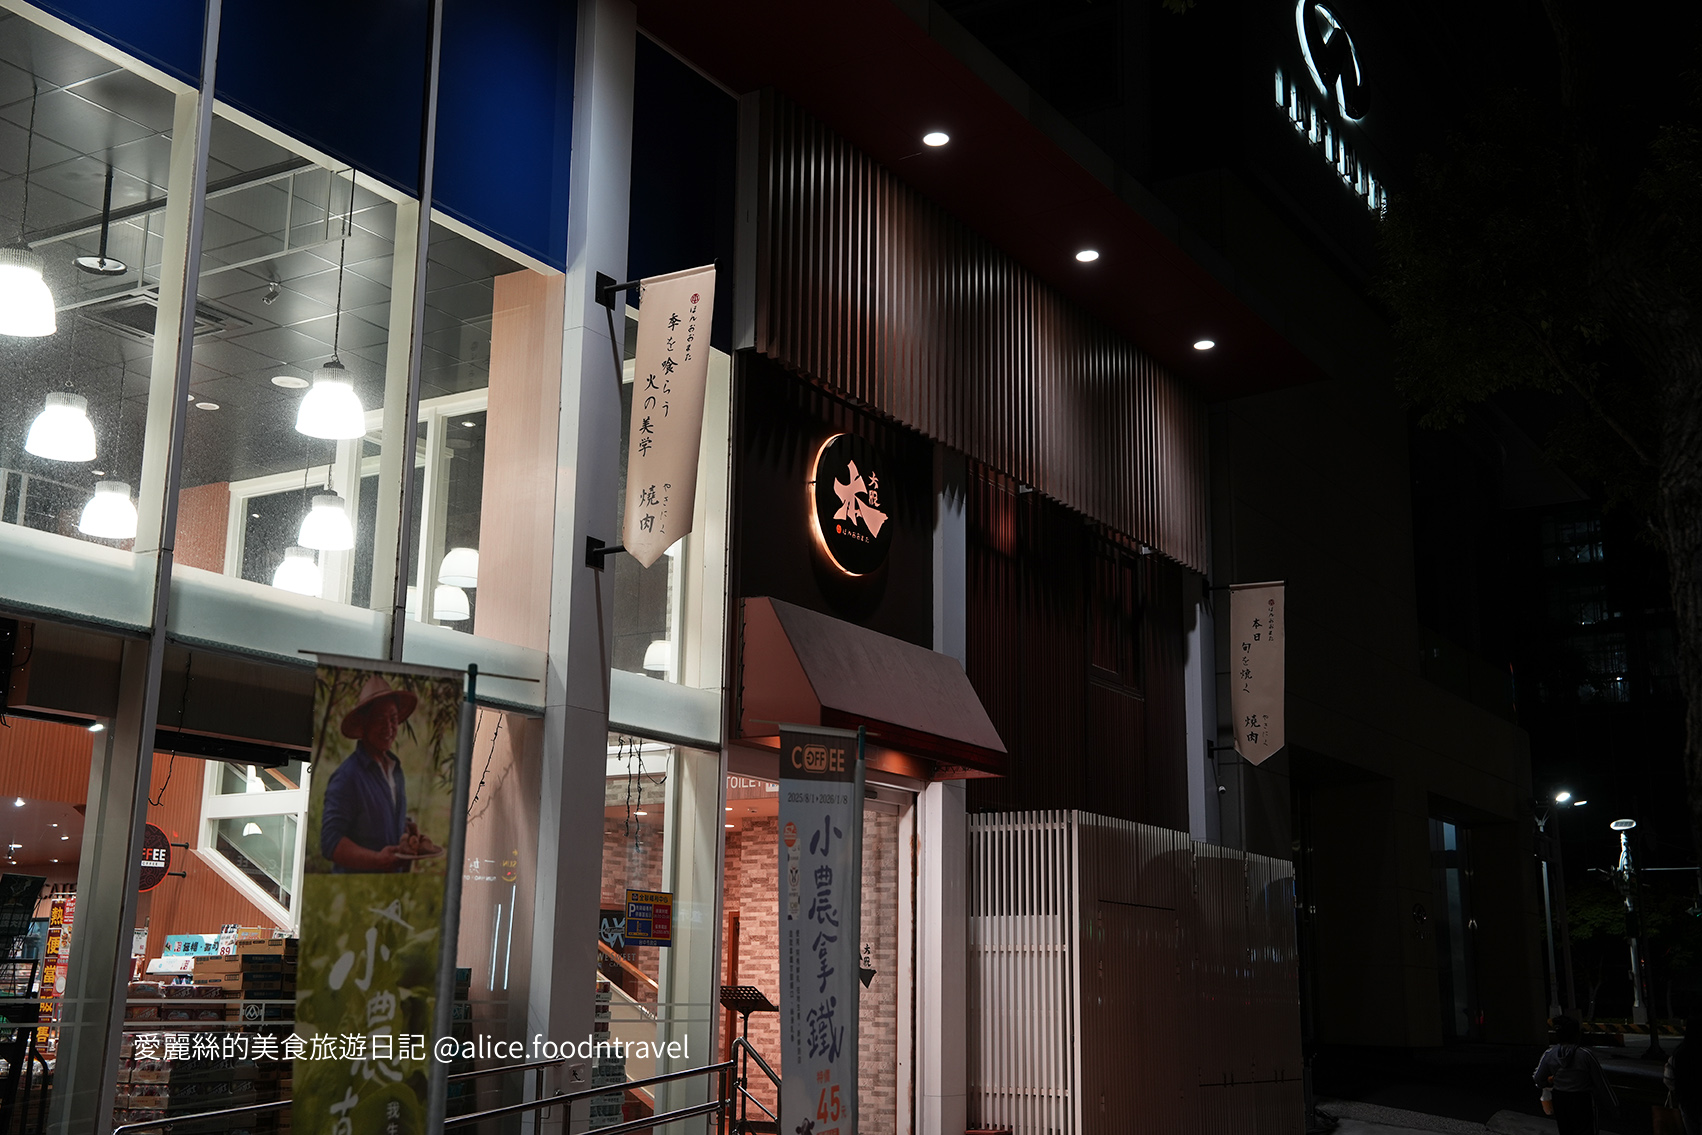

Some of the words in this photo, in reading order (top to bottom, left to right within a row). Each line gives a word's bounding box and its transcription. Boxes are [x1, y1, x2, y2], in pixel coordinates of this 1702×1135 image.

[638, 373, 660, 457] 火の美学
[659, 482, 672, 535] やきにく
[1252, 618, 1263, 642] 本日
[806, 814, 845, 1063] 小農拿鐵
